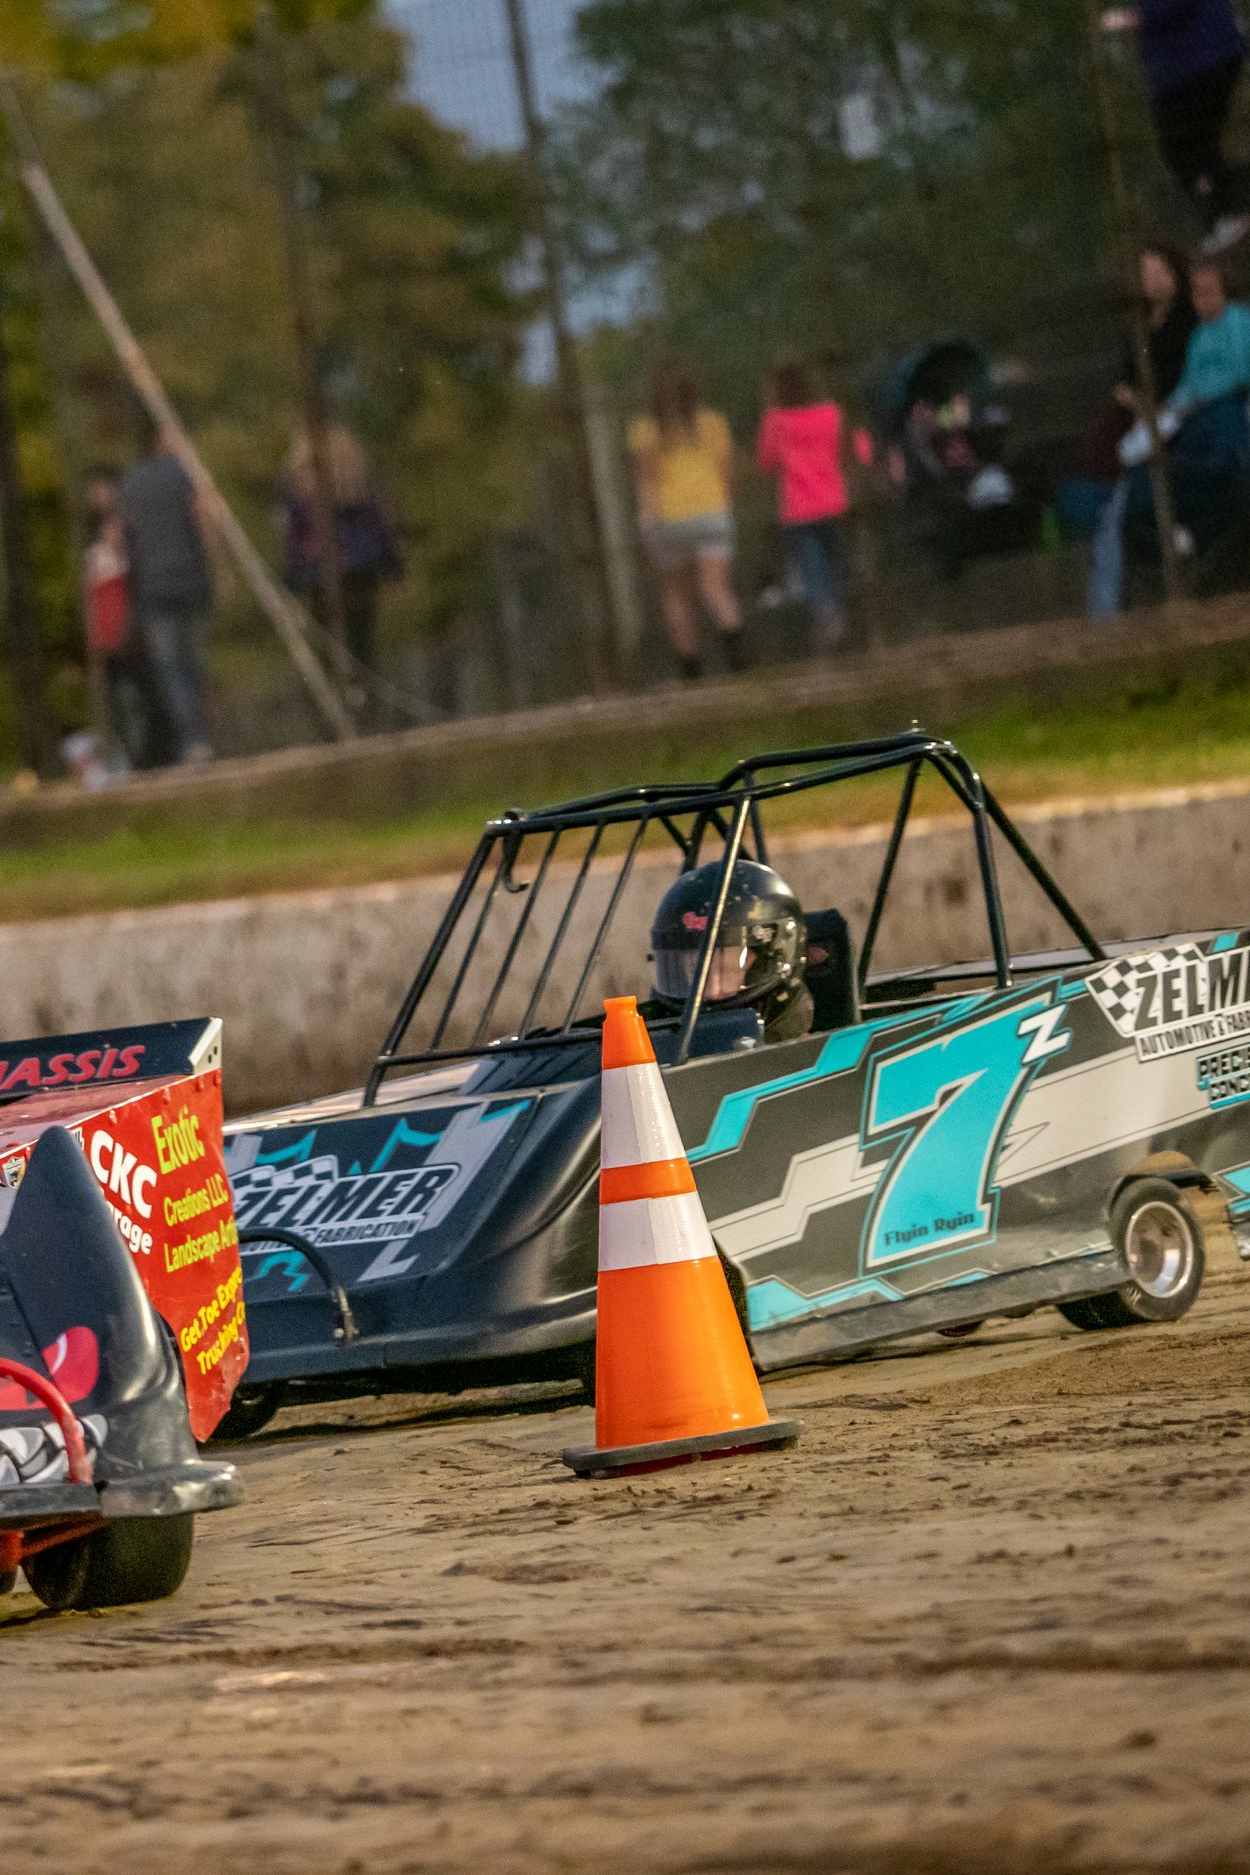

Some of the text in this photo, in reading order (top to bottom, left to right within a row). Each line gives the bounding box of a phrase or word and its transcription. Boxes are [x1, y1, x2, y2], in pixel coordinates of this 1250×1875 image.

[1135, 952, 1250, 1032] ZELM
[151, 1104, 206, 1174] Exotic
[866, 990, 1052, 1268] 7
[90, 1129, 158, 1219] CKC
[164, 1173, 229, 1227] Creations LLC
[233, 1168, 455, 1229] ZELMER
[106, 1200, 153, 1255] rage
[164, 1230, 221, 1273] Landscape
[316, 1220, 416, 1243] FABRICATION
[885, 1223, 928, 1246] Flyin
[180, 1317, 203, 1352] Get
[197, 1299, 221, 1331] Toe
[196, 1316, 239, 1375] Trucking
